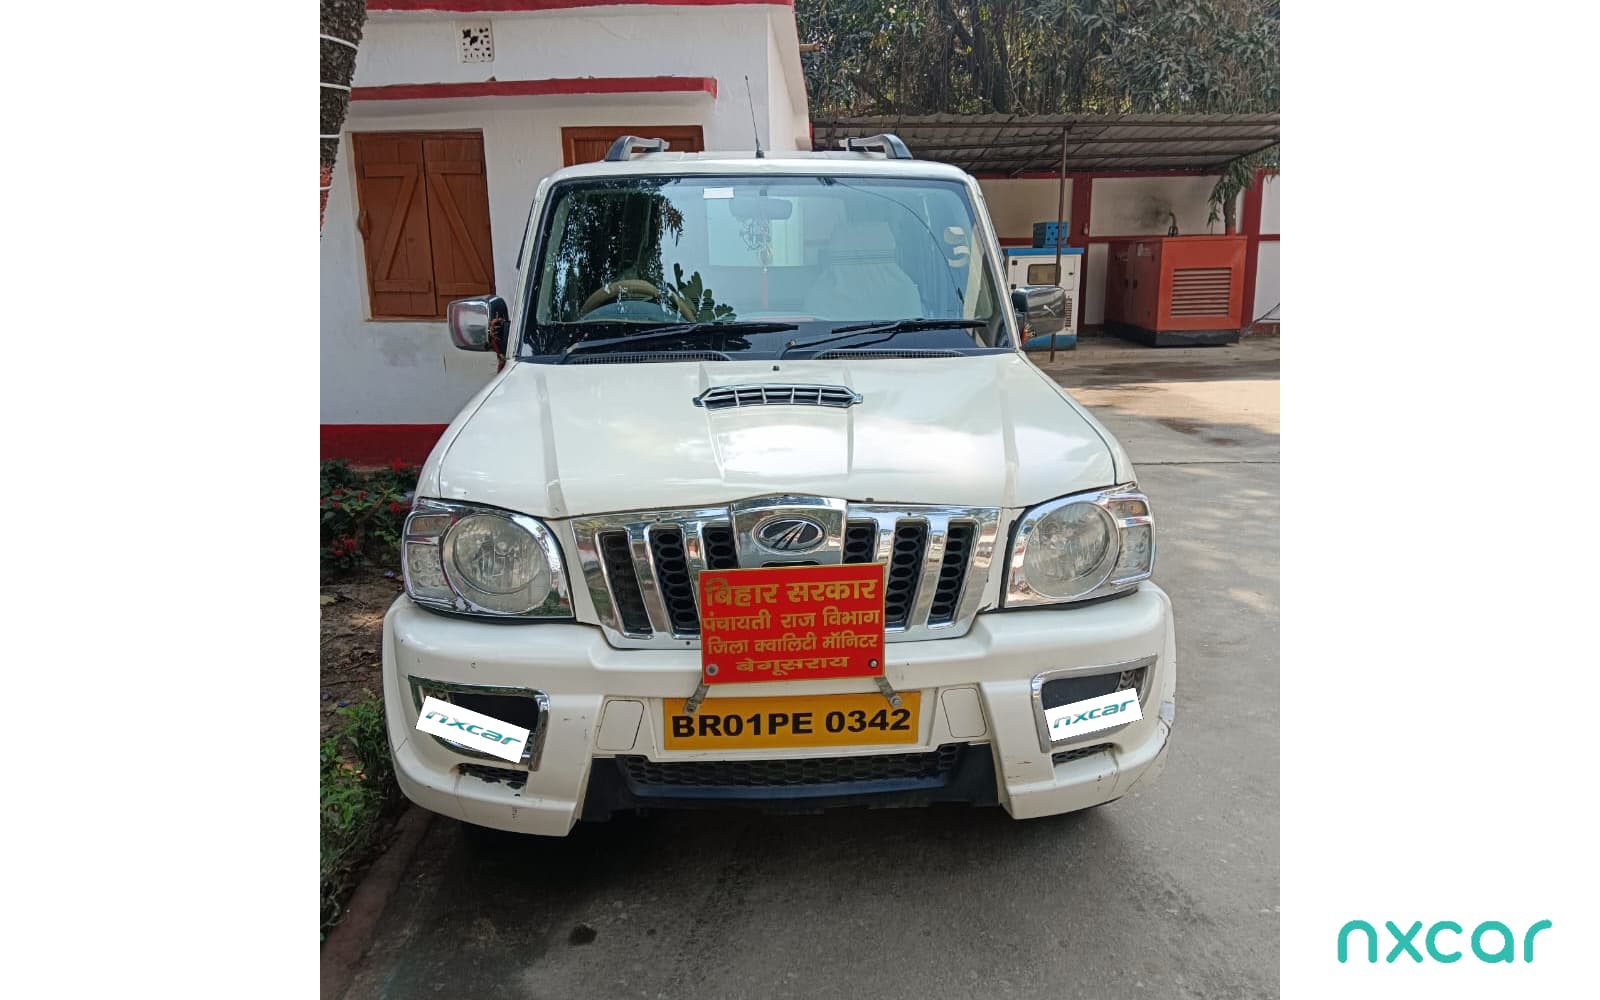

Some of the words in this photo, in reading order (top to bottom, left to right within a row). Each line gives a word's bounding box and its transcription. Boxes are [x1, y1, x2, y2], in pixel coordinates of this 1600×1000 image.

[705, 578, 779, 608] बिहार
[786, 579, 877, 602] सरकार
[702, 611, 771, 632] पंचायती
[781, 611, 815, 629] राज
[822, 606, 880, 627] विभाग
[708, 637, 748, 655] जिला
[754, 632, 817, 653] क्वालिटी
[822, 630, 878, 650] मॉनिटर
[735, 656, 849, 676] बेगूसराय
[672, 712, 813, 738] BR01PE
[825, 708, 911, 733] 0342
